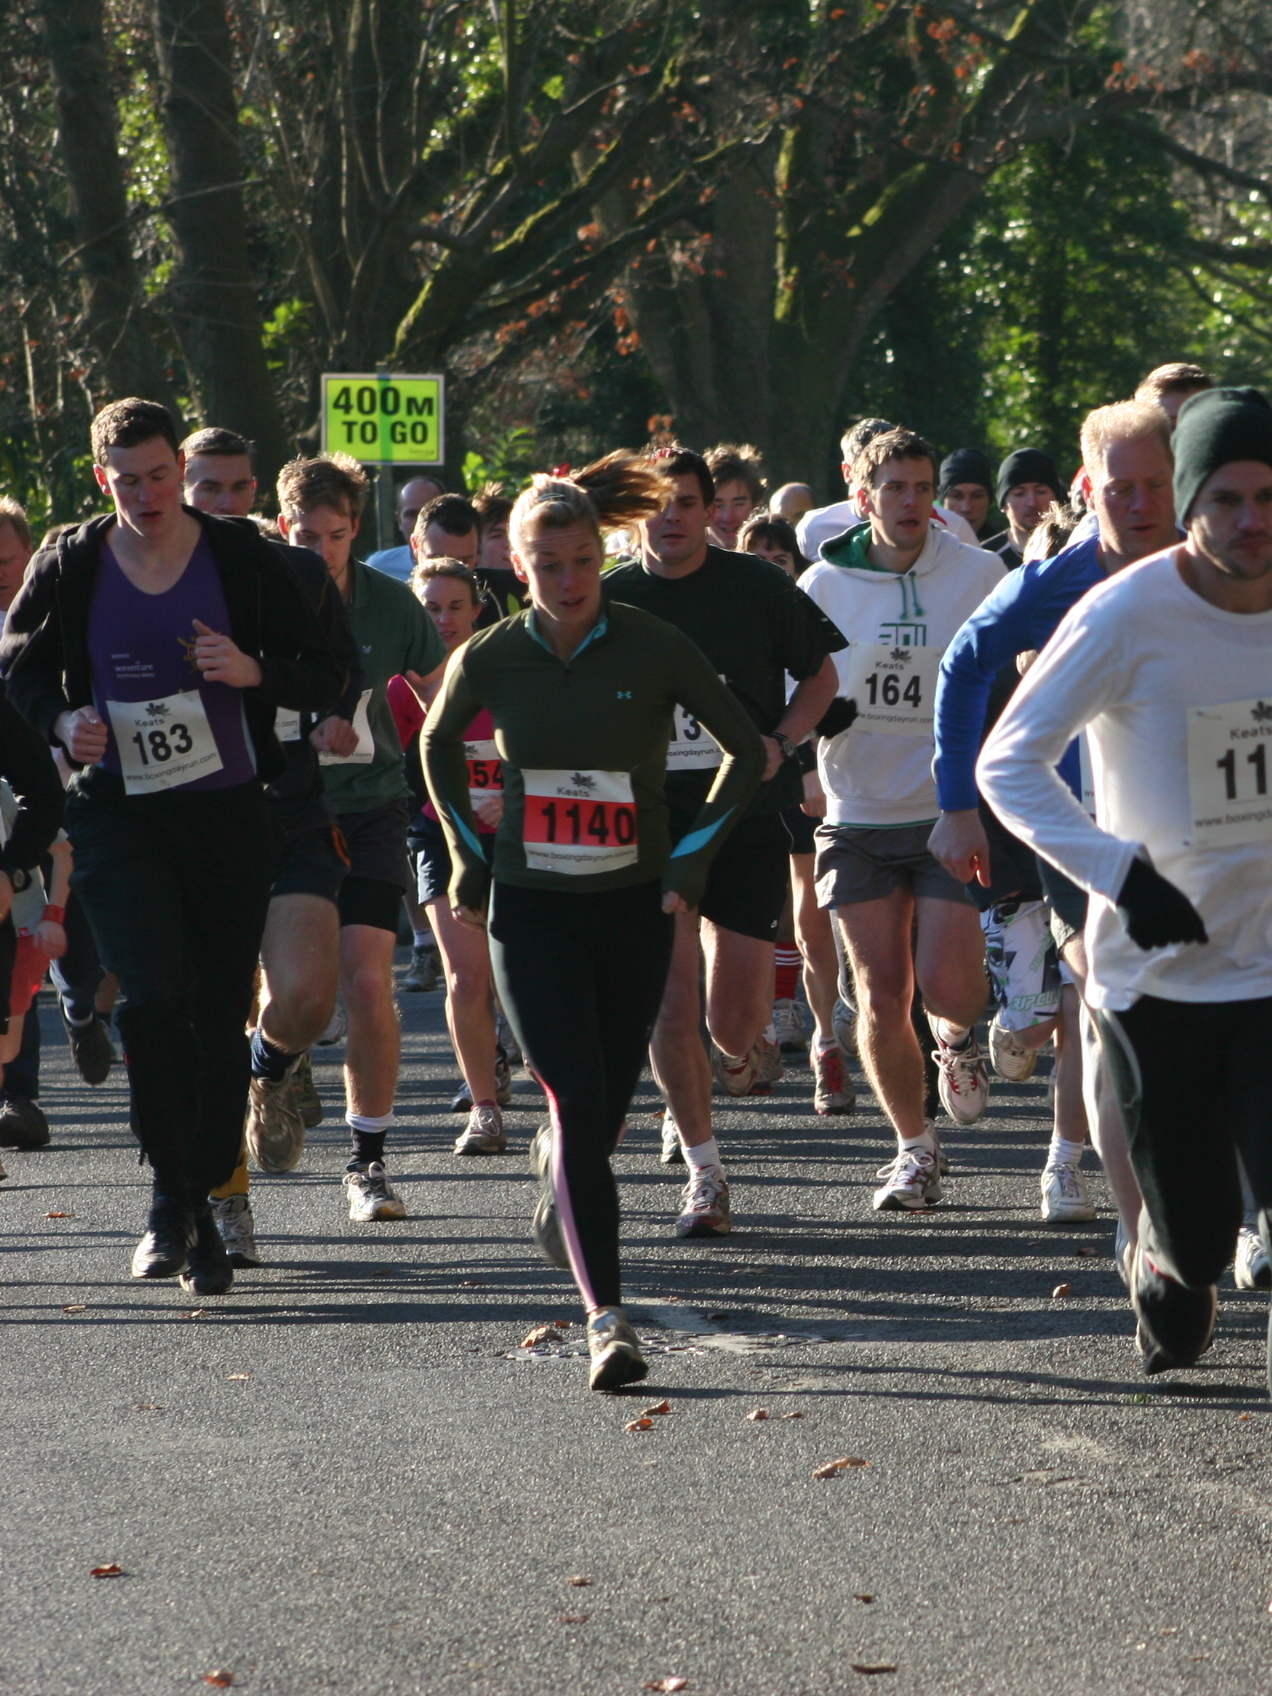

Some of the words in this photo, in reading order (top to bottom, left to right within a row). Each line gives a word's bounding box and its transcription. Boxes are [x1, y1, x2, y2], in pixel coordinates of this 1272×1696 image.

[342, 420, 378, 444] TO
[390, 420, 428, 444] GO
[875, 661, 905, 670] Keats
[865, 673, 922, 708] 164
[134, 718, 165, 727] Keats
[132, 723, 193, 766] 183
[125, 752, 217, 781] www.boxingdayrun.com
[556, 787, 590, 797] Keats
[541, 802, 636, 845] 1140
